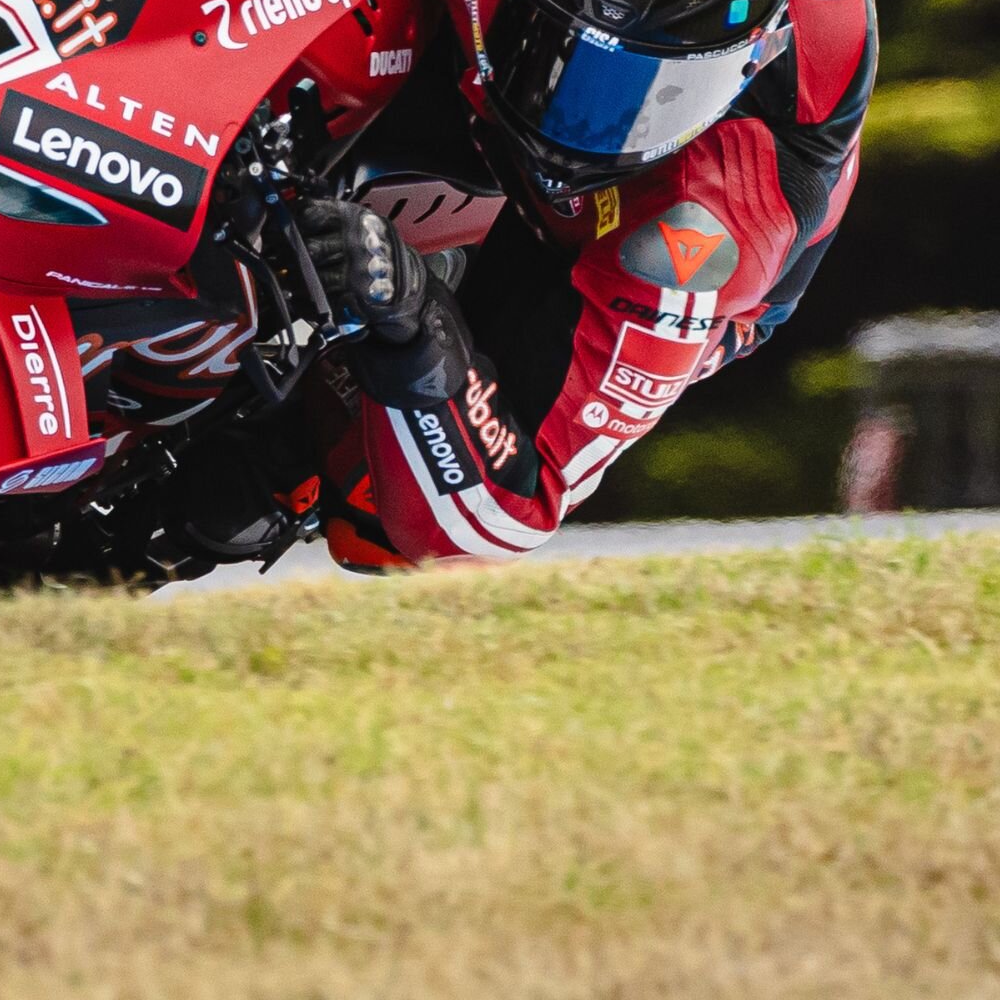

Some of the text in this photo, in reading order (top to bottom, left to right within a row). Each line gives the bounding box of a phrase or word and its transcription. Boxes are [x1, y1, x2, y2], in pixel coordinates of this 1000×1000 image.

[369, 48, 413, 77] DUCATI
[44, 71, 220, 157] ALTEN
[12, 107, 184, 207] Lenovo
[413, 409, 465, 485] enovo
